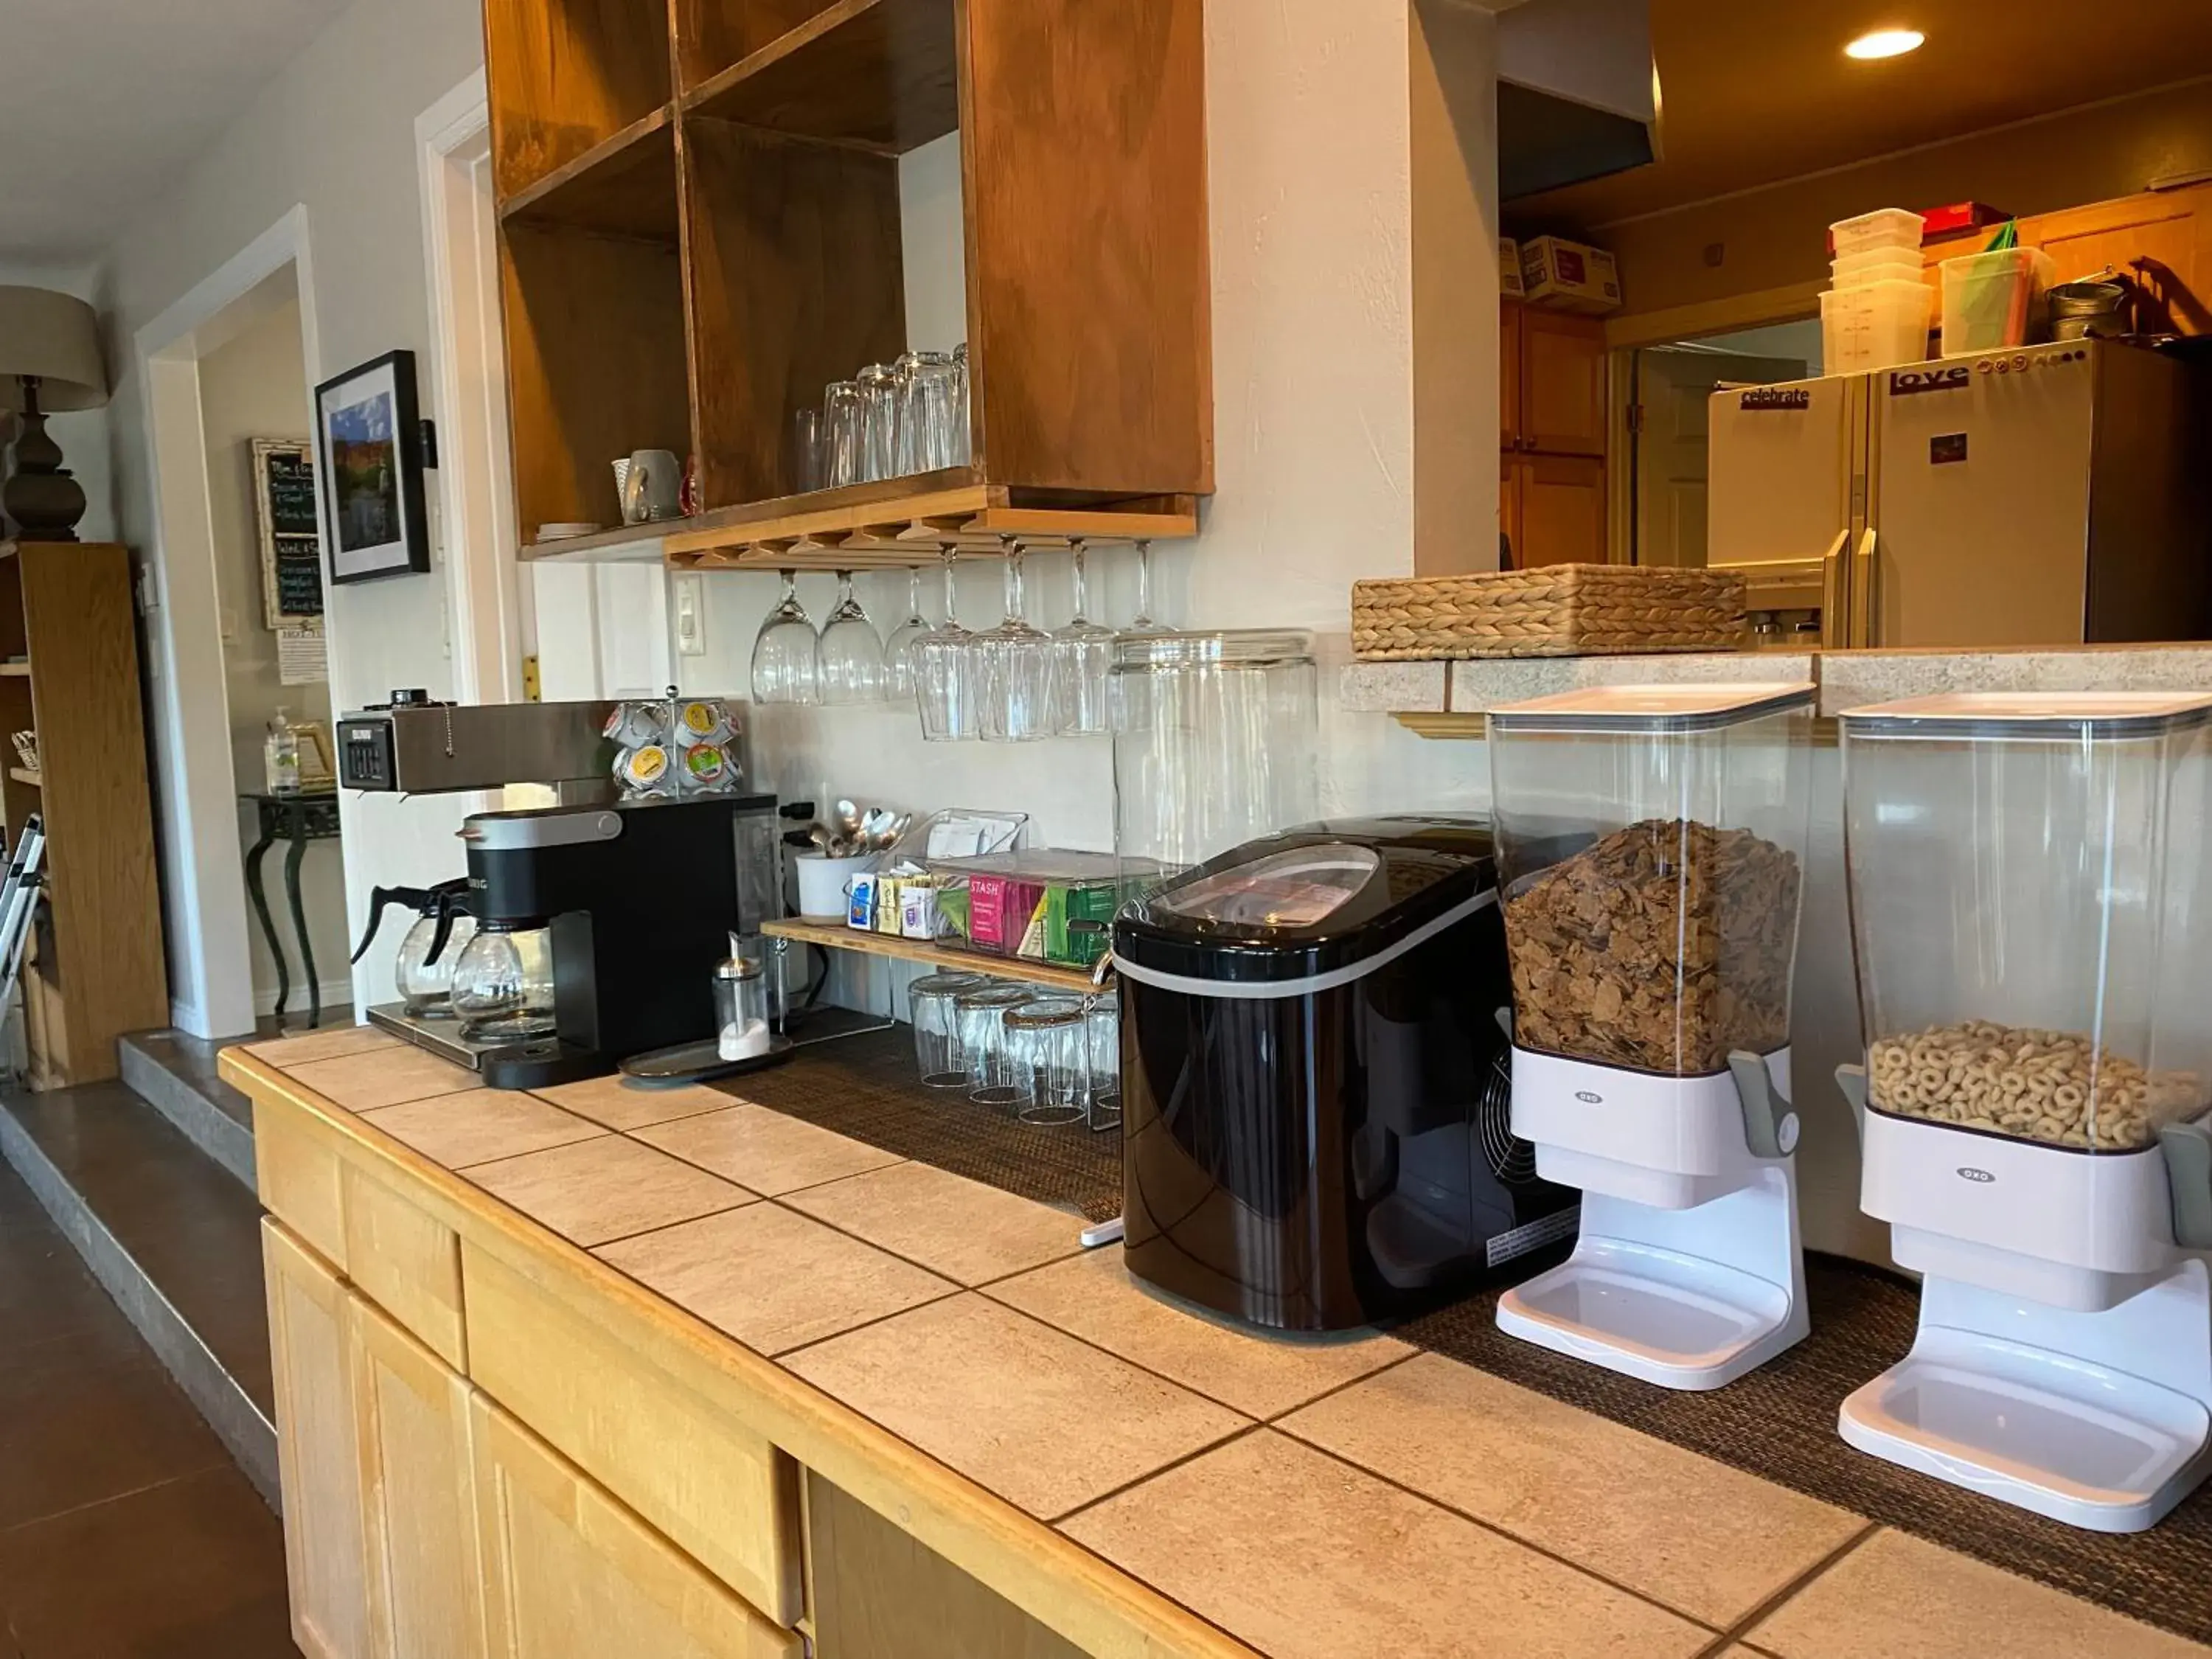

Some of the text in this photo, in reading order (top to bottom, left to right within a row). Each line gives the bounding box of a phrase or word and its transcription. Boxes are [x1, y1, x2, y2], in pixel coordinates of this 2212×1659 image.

[1890, 366, 1969, 395] love
[1741, 388, 1809, 407] celebrate
[971, 881, 999, 896] STASH
[1579, 1093, 1599, 1102] OXO
[1962, 1169, 1990, 1181] OXO
